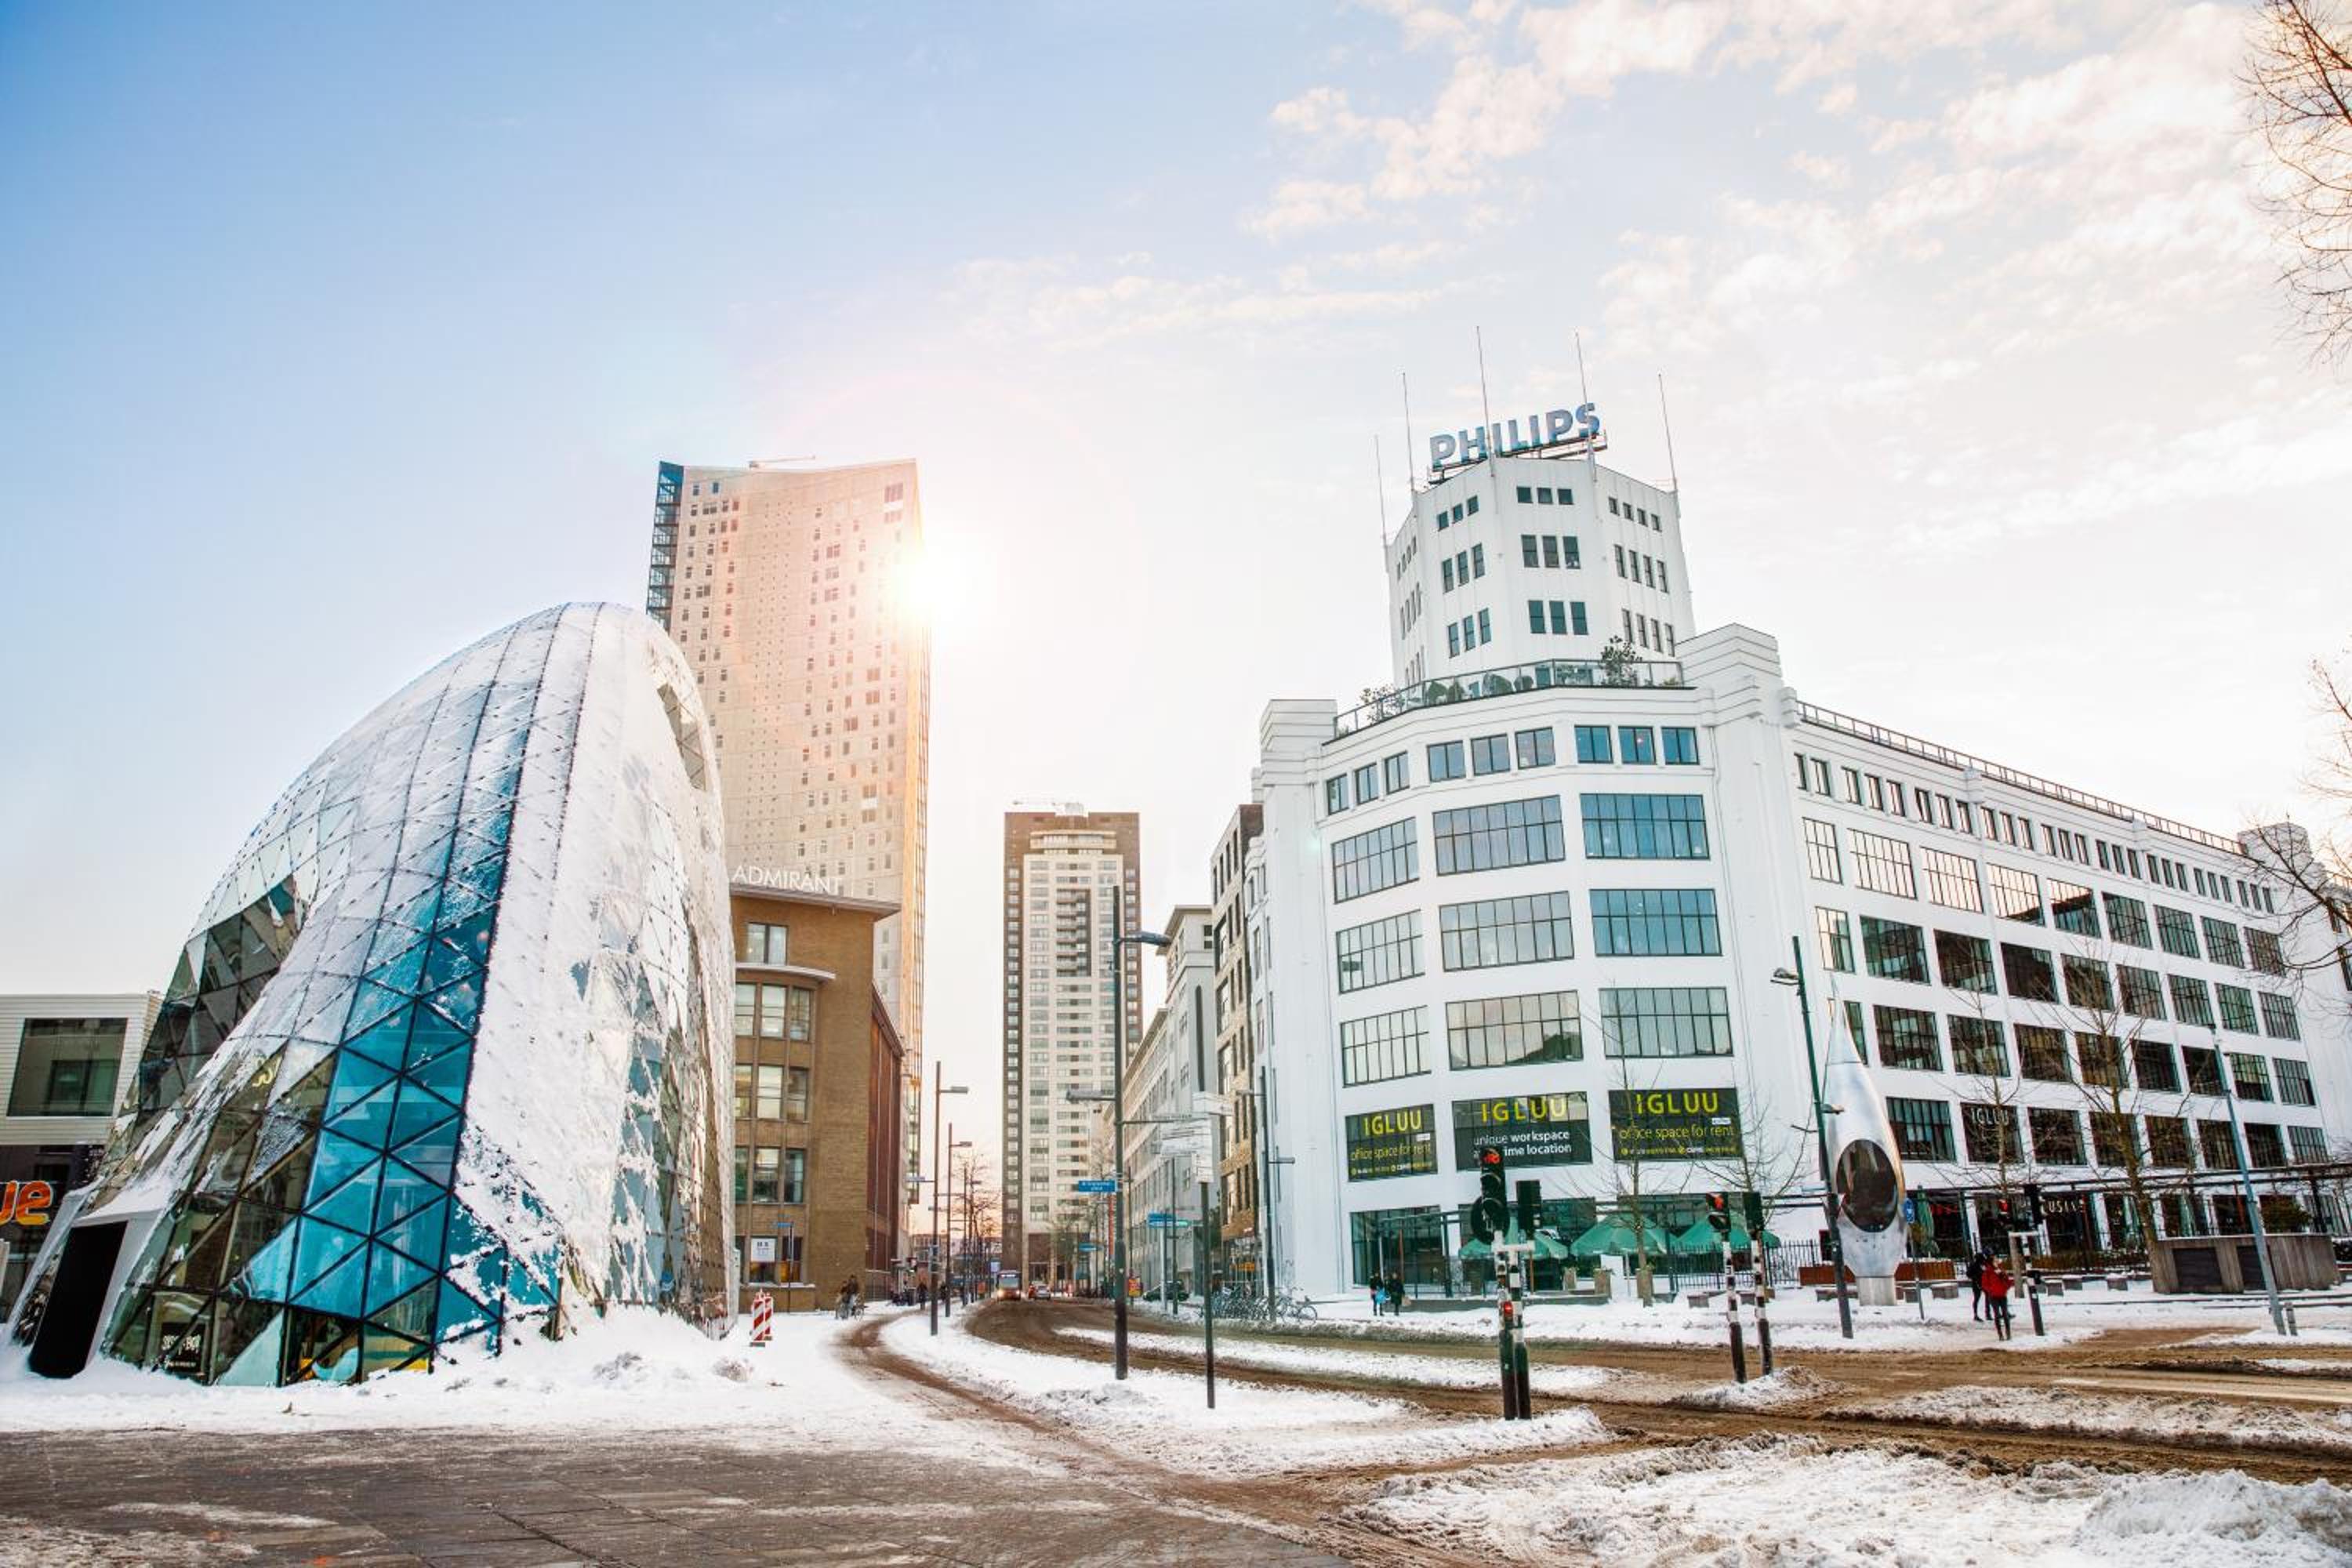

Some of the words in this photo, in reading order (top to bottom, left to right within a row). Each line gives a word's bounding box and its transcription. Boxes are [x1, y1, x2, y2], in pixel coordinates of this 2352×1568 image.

[1429, 402, 1601, 470] PHILIPS
[731, 864, 842, 896] ADMIRANT
[1481, 1097, 1567, 1123] IGLUU
[1635, 1092, 1719, 1114] IGLUU
[1364, 1109, 1422, 1137] IGLUU
[1655, 1128, 1689, 1140] space
[1690, 1123, 1708, 1137] for
[1710, 1124, 1734, 1136] rent
[1474, 1135, 1508, 1147] unique
[1510, 1130, 1570, 1142] workspace
[1526, 1142, 1572, 1155] location
